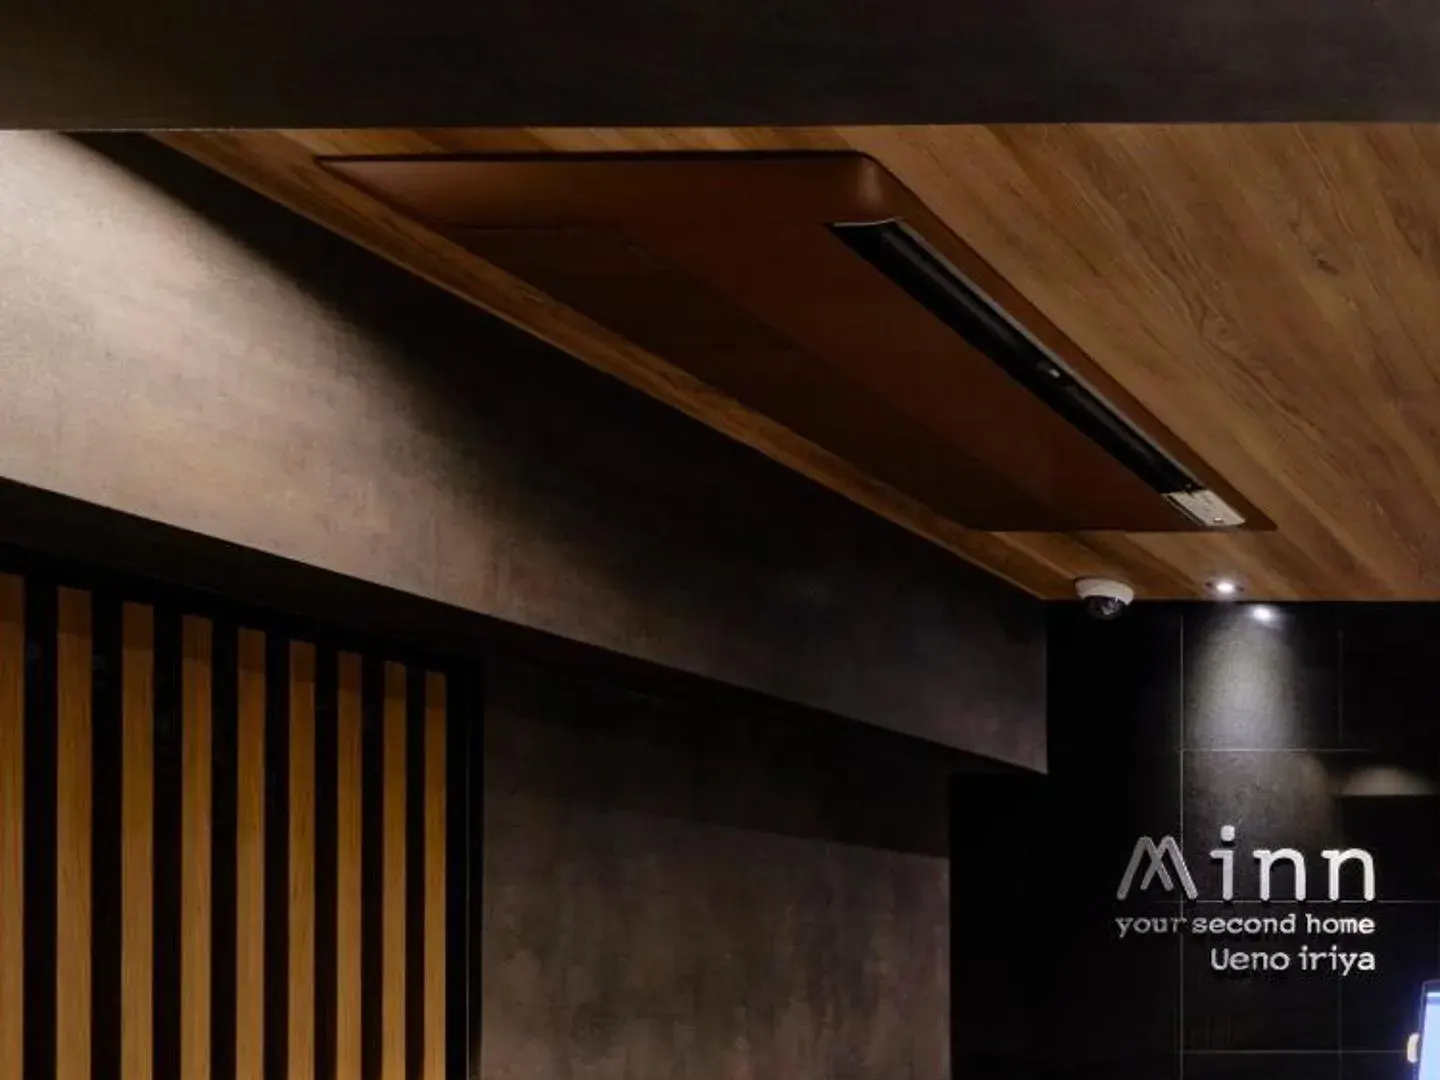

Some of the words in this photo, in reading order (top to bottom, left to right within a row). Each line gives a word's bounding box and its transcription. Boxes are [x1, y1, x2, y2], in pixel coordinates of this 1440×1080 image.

[1116, 824, 1376, 901] Minn
[1115, 916, 1187, 938] your
[1191, 913, 1296, 934] second
[1305, 913, 1376, 934] home
[1210, 947, 1290, 971] Ueno
[1298, 945, 1376, 976] iriya
